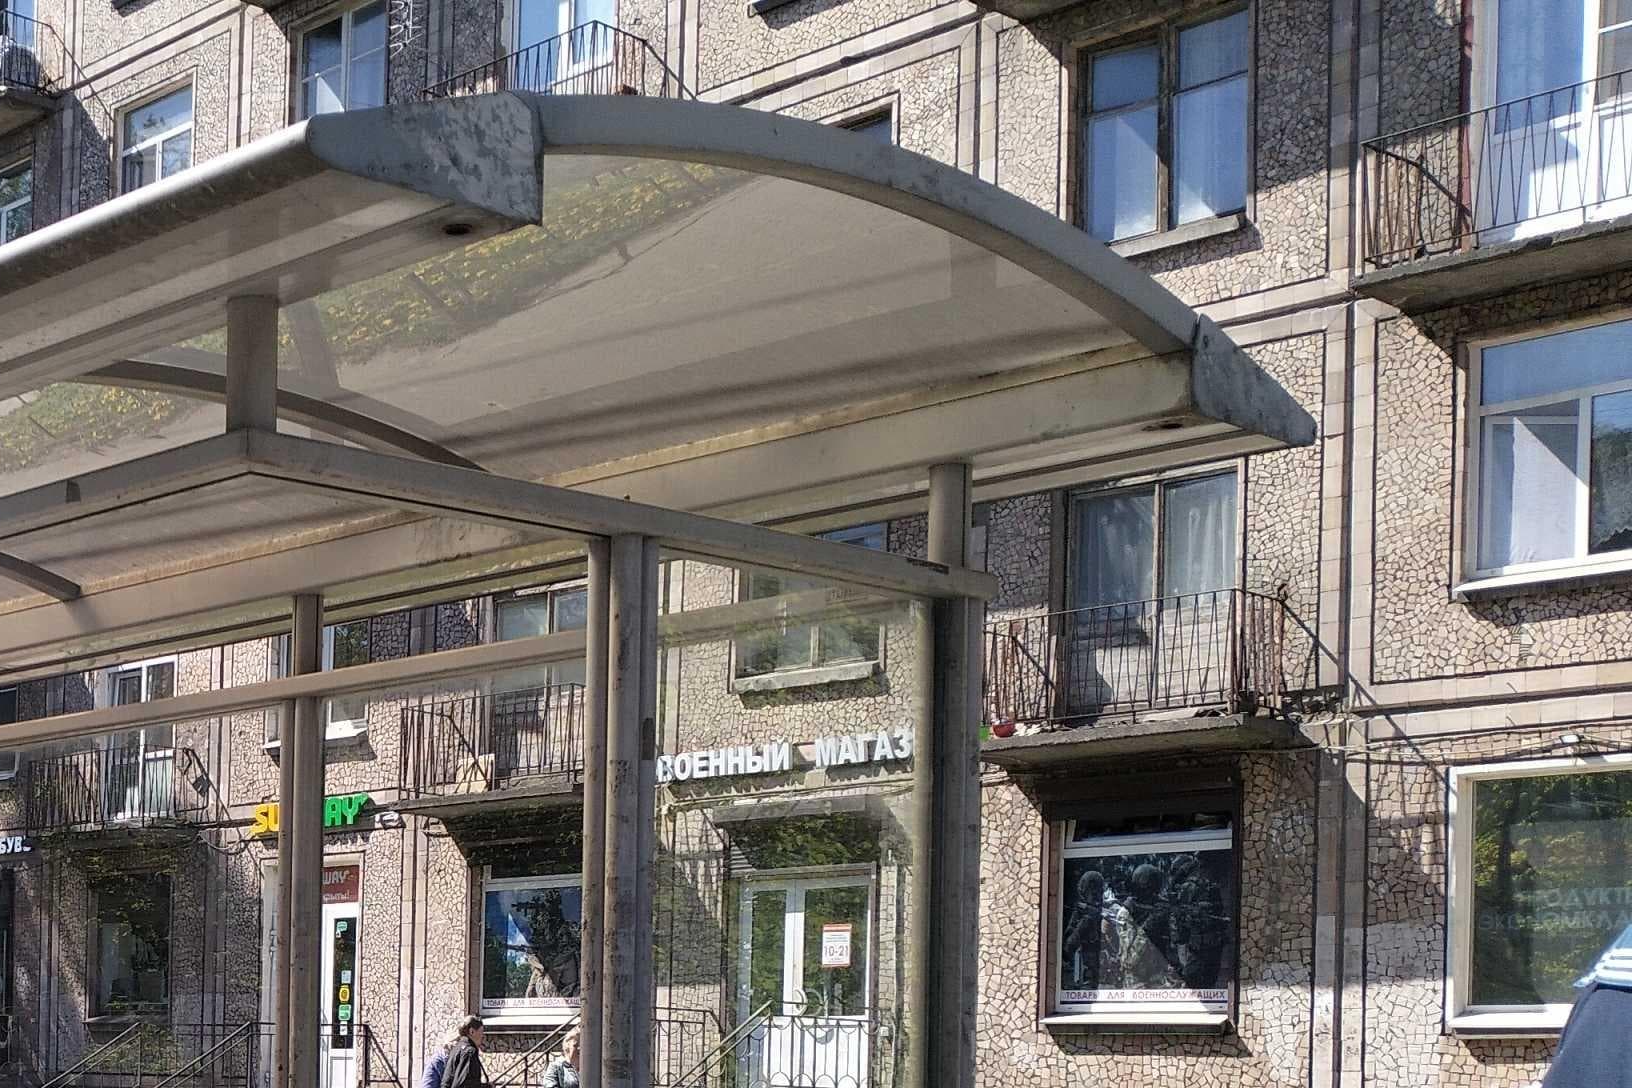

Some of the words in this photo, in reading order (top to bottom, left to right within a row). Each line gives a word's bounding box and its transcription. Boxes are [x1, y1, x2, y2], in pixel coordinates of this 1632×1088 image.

[658, 736, 793, 782] ВОЕННЫЙ
[815, 728, 913, 769] МАГАЗ
[251, 792, 368, 834] SUAY
[1107, 991, 1125, 1000] ДЛЯ
